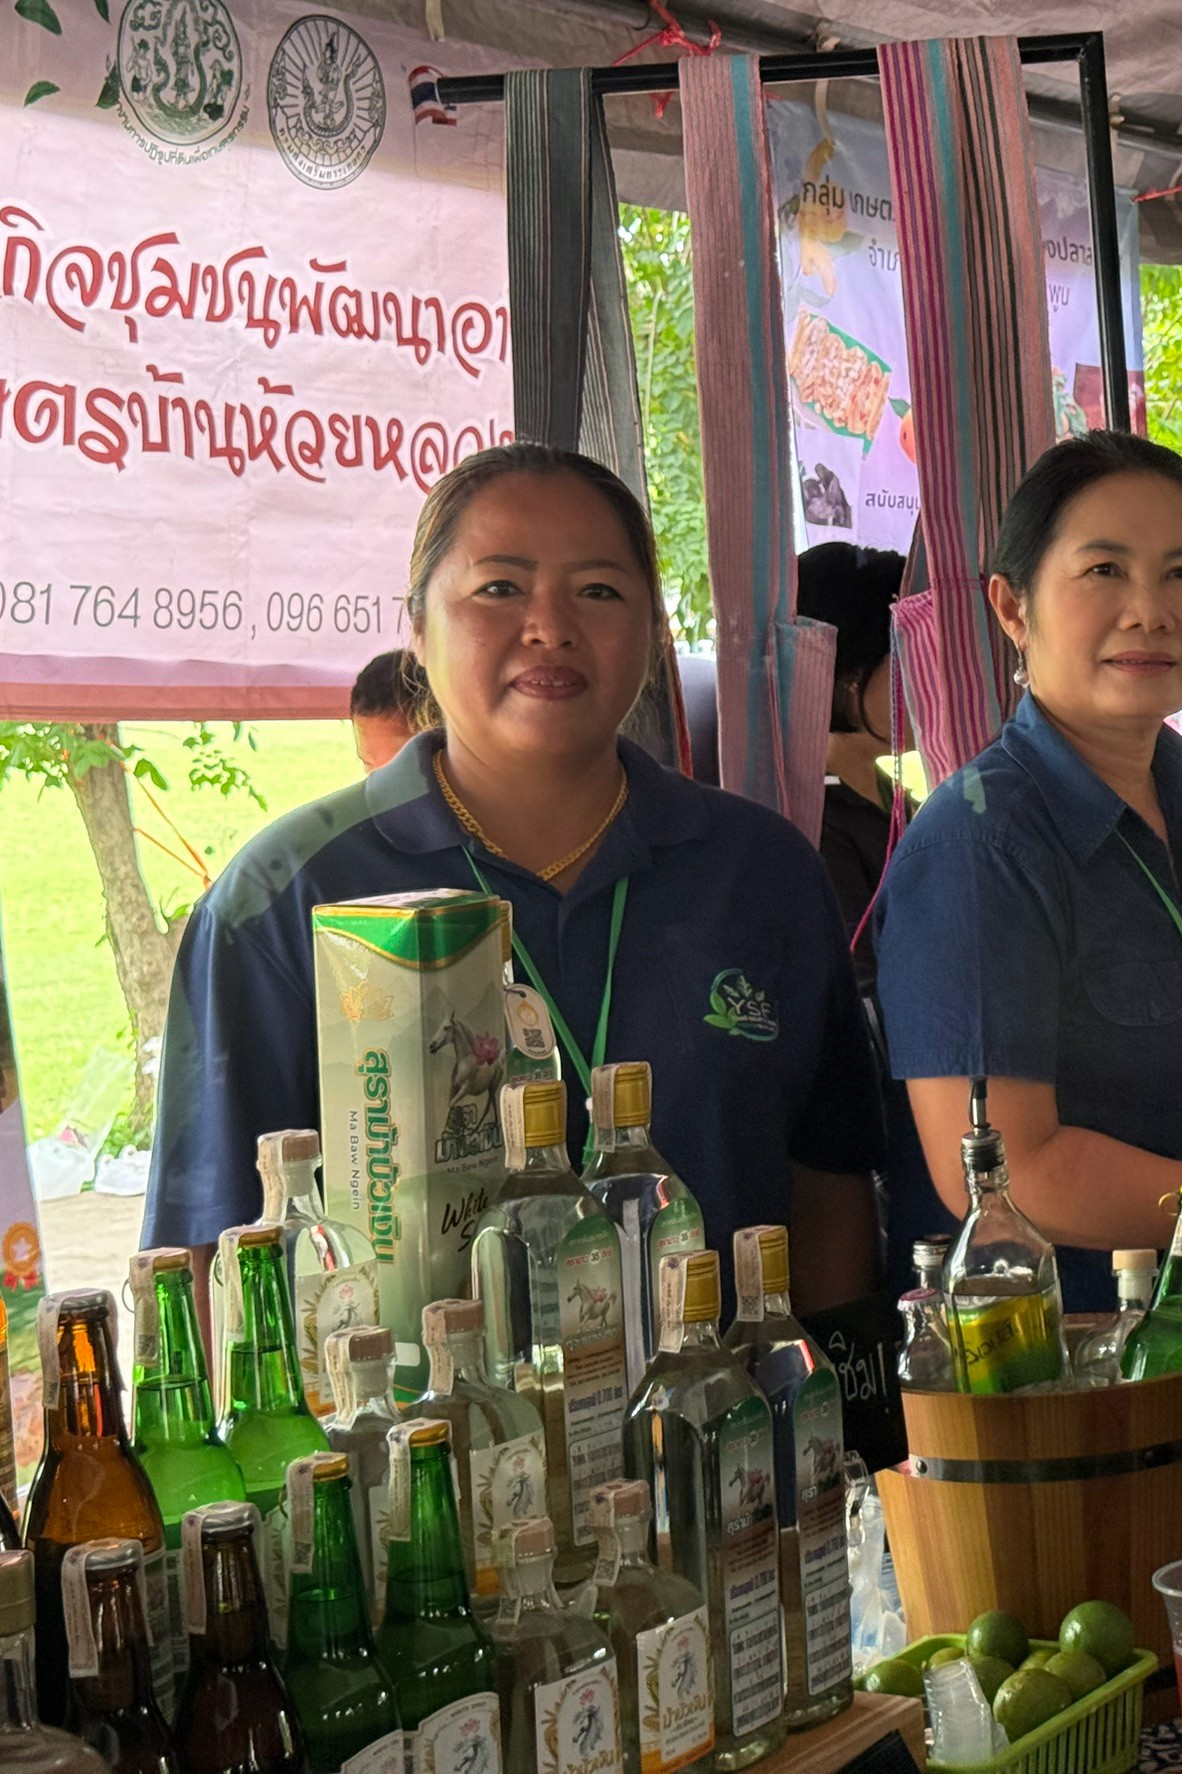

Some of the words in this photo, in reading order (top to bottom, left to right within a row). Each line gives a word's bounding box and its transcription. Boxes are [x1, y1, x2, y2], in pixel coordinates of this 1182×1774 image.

[802, 174, 845, 216] กลุ่ม
[849, 190, 894, 222] เกษต
[69, 584, 141, 629] 764
[266, 590, 324, 632] 096
[333, 593, 382, 635] 651
[726, 996, 772, 1018] YSF
[349, 1110, 358, 1131] Ma
[350, 1135, 360, 1166] Baw
[349, 1169, 361, 1211] Ngein
[440, 1186, 490, 1236] White
